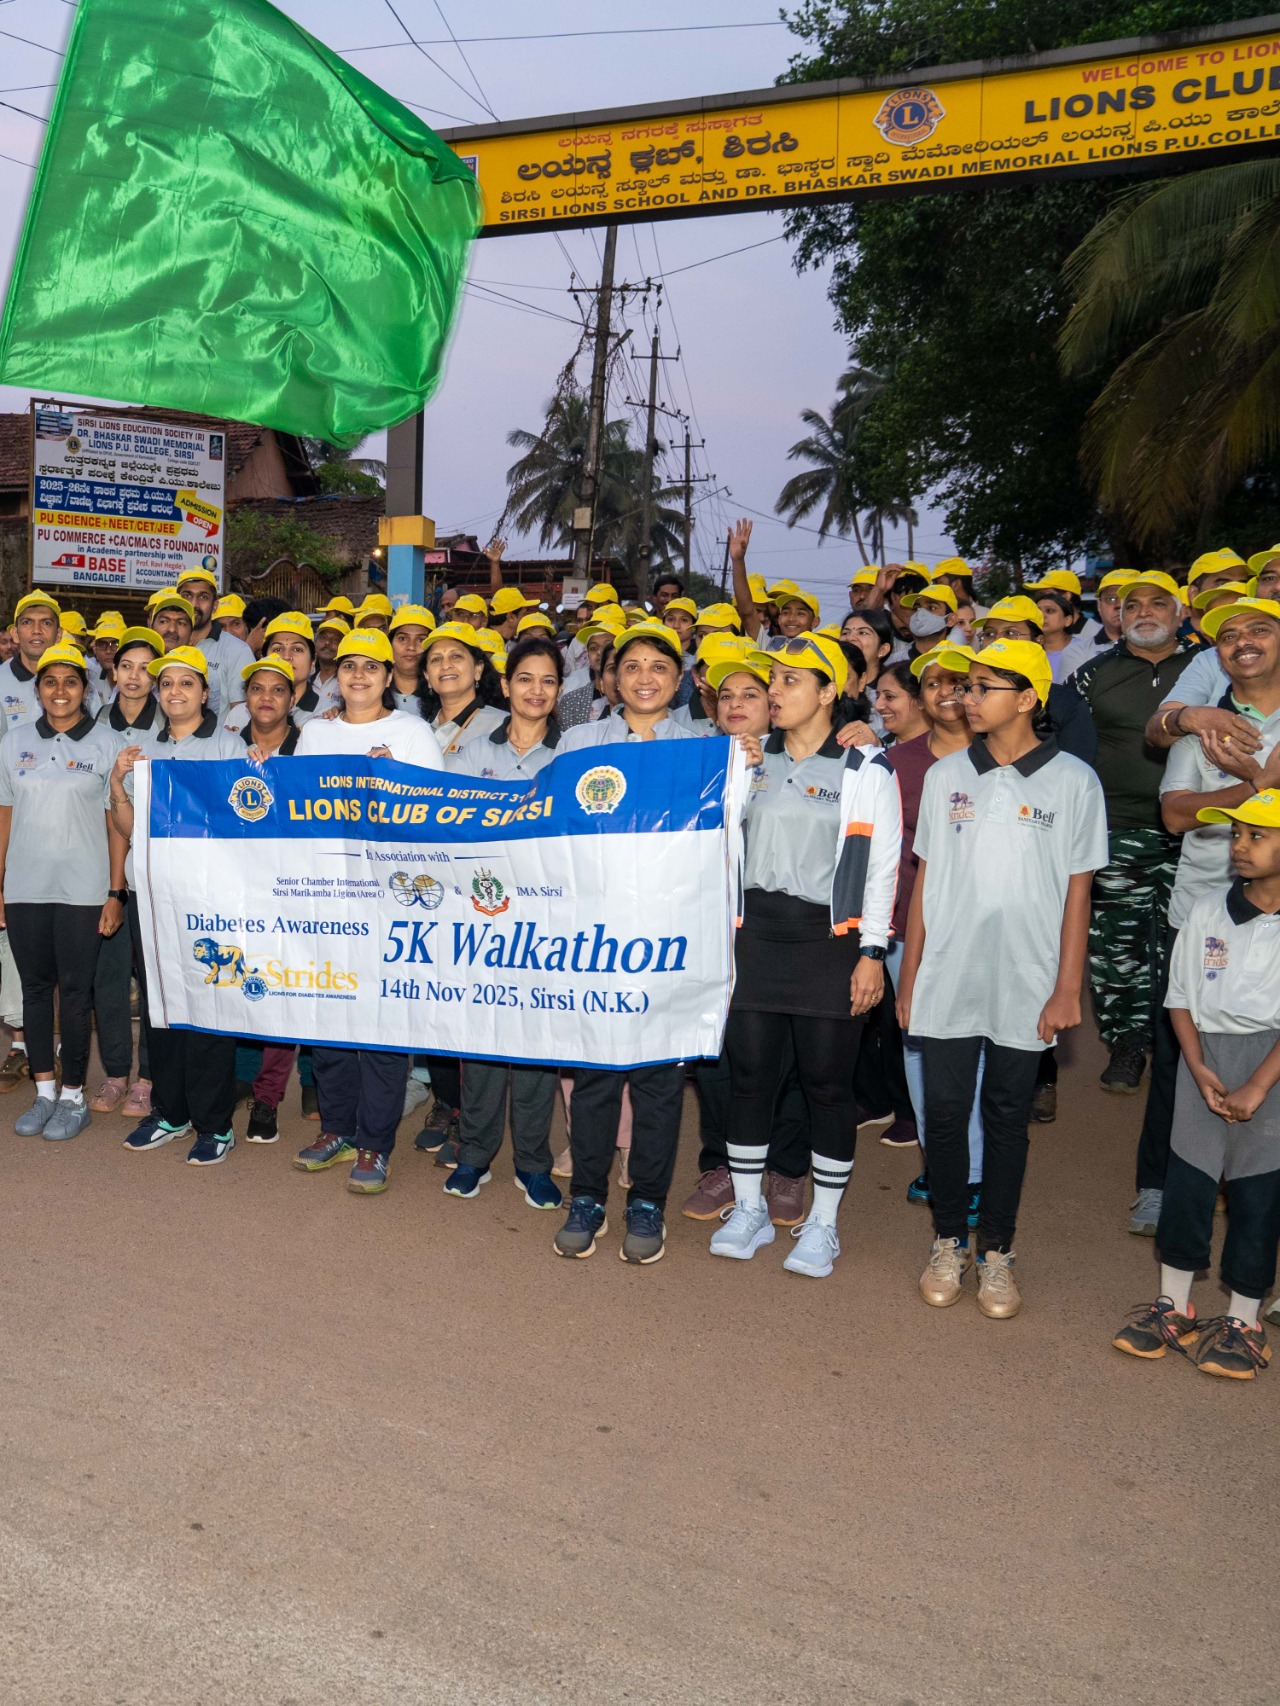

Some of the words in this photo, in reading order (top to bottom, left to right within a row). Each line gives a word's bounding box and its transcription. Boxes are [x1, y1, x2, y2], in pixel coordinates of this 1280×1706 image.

[1082, 56, 1188, 84] WELCOME
[1196, 51, 1225, 67] TO
[891, 91, 929, 105] LIONS
[1024, 85, 1156, 124] LIONS
[902, 106, 919, 125] L
[722, 131, 798, 158] ಶಿರಸಿ
[499, 207, 545, 222] SIRSI
[552, 201, 607, 217] LIONS
[613, 193, 690, 210] SCHOOL
[698, 187, 738, 202] AND
[745, 184, 777, 197] DR.
[784, 172, 882, 193] BHASKAR
[887, 164, 953, 182] SWADI
[962, 150, 1079, 174] MEMORIAL
[1088, 139, 1157, 160] LIONS
[501, 190, 540, 204] ಶಿರಸಿ
[680, 169, 727, 185] ಮತ್ತು
[77, 418, 97, 428] SIRSI
[99, 421, 120, 431] LIONS
[122, 423, 162, 436] EDUCATION
[164, 428, 194, 440] SOCIETY
[195, 432, 205, 441] (R)
[77, 428, 91, 438] DR.
[94, 430, 132, 442] BHASKAR
[134, 435, 160, 446] SWADI
[163, 438, 205, 452] MEMORIAL
[88, 439, 113, 450] LIONS
[115, 442, 131, 452] P.U.
[134, 444, 172, 457] COLLEGE,
[174, 449, 194, 460] SIRSI
[180, 498, 217, 519] ADMISSION
[40, 512, 54, 524] PU
[193, 517, 212, 530] OPEN
[37, 529, 50, 541] PU
[53, 530, 106, 545] COMMERCE
[163, 539, 220, 555] FOUNDATION
[77, 545, 84, 553] in
[86, 545, 122, 556] Academic
[124, 549, 166, 561] partnership
[168, 552, 183, 561] with
[88, 557, 126, 573] BASE
[136, 569, 180, 578] ACCOUNTANCY
[73, 571, 126, 584] BANGALORE
[76, 762, 94, 771] Bell
[238, 780, 262, 789] LIONS
[319, 776, 353, 788] LIONS
[356, 777, 444, 797] INTERNATIONAL
[447, 788, 509, 801] DISTRICT
[817, 787, 841, 800] Bell
[246, 791, 257, 806] L
[288, 799, 361, 821] LIONS
[367, 801, 429, 824] CLUB
[436, 806, 477, 825] OF
[481, 796, 553, 827] SIRSI
[1032, 807, 1055, 825] Bell
[366, 849, 373, 860] In
[374, 851, 426, 863] Association
[429, 851, 450, 863] with
[276, 876, 299, 887] Senior
[301, 876, 334, 887] Chamber
[336, 877, 380, 888] International
[454, 886, 462, 896] &
[272, 888, 288, 897] Sirsi
[290, 888, 331, 898] Marikamba
[357, 889, 375, 900] (Area
[377, 890, 385, 899] C)
[517, 886, 538, 897] IMA
[540, 886, 563, 897] Sirsi
[186, 914, 265, 933] Diabetes
[271, 916, 369, 936] Awareness
[383, 920, 438, 964] 5K
[452, 921, 687, 974] Walkathon
[265, 959, 359, 991] Strides
[380, 978, 420, 1000] 14th
[426, 980, 466, 1002] Nov
[472, 983, 524, 1011] 2025,
[529, 987, 576, 1011] Sirsi
[582, 988, 650, 1015] (N.K.)
